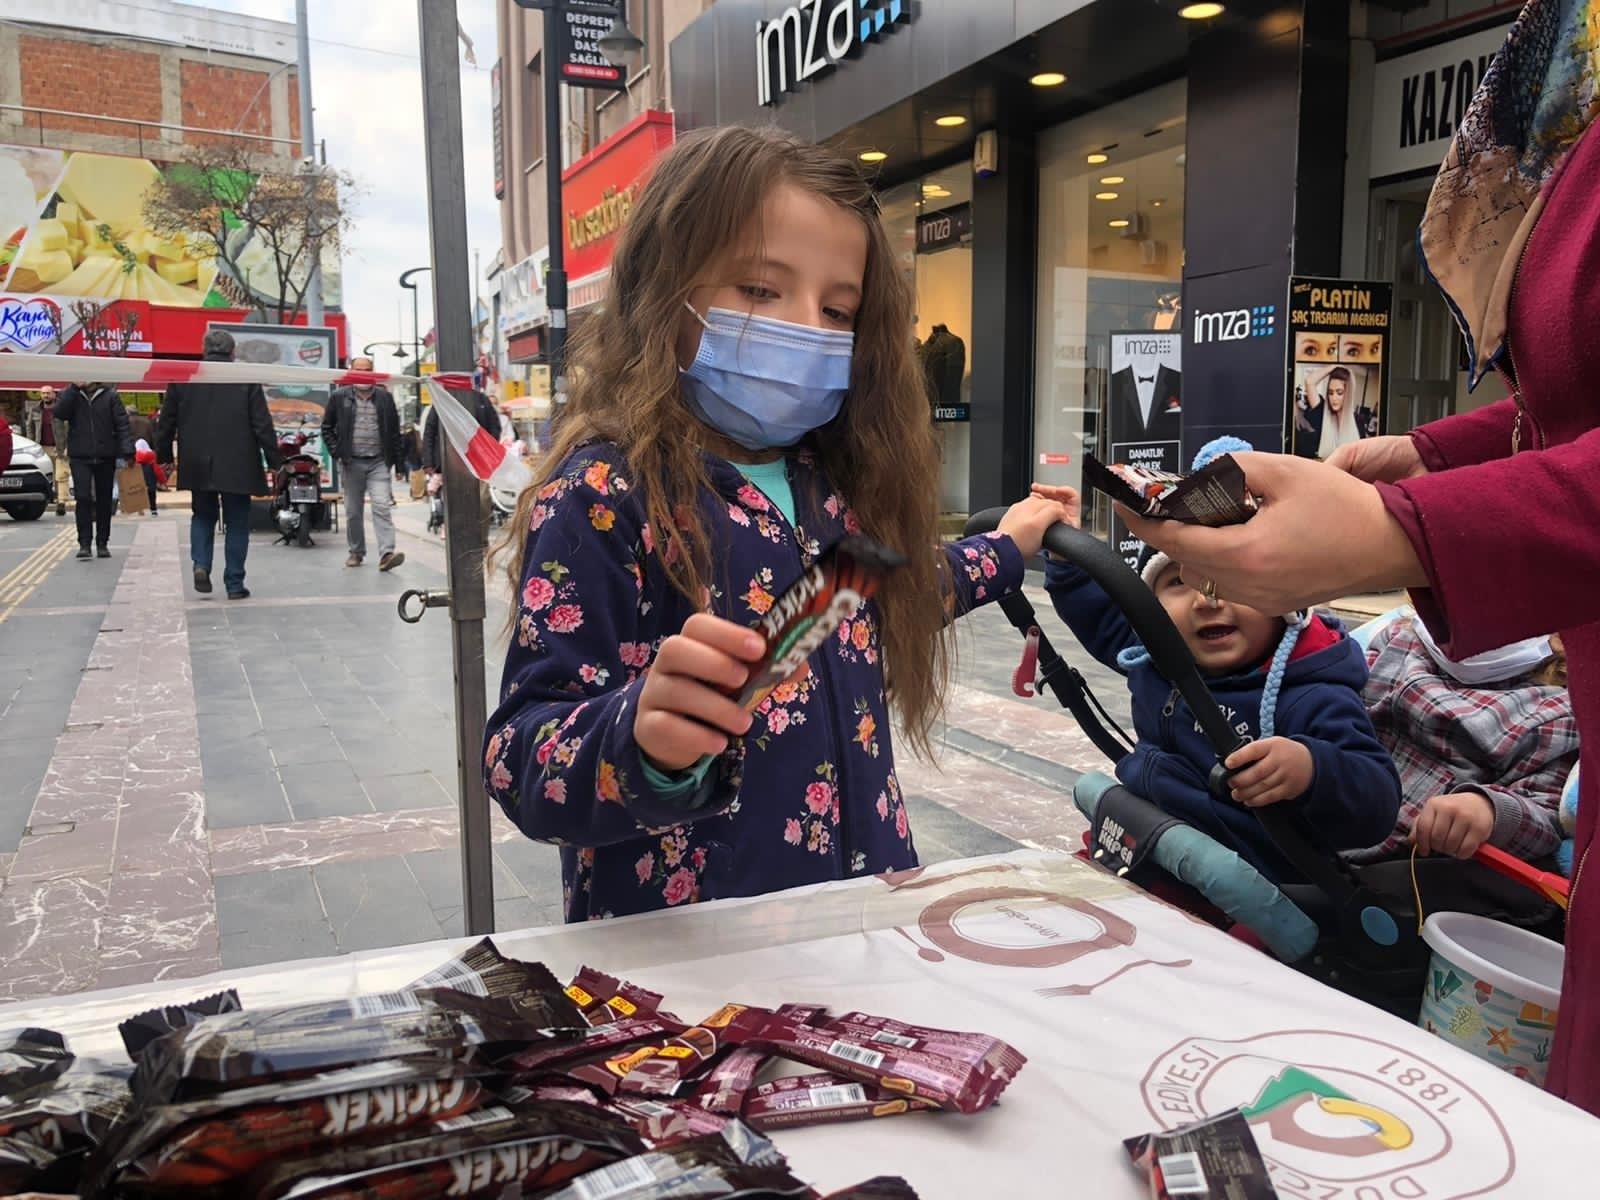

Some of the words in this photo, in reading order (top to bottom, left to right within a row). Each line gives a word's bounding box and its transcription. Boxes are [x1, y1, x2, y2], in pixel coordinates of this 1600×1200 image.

[566, 12, 614, 29] DEPREM
[755, 0, 854, 106] imza
[922, 217, 951, 244] imza
[1310, 285, 1371, 310] PLATİN
[1194, 309, 1250, 344] imza
[1291, 310, 1309, 327] SAÇ
[1310, 311, 1348, 325] TASARIM
[1125, 338, 1158, 355] imza
[1129, 447, 1164, 460] DAMATLIK
[1376, 1057, 1462, 1115] 1881
